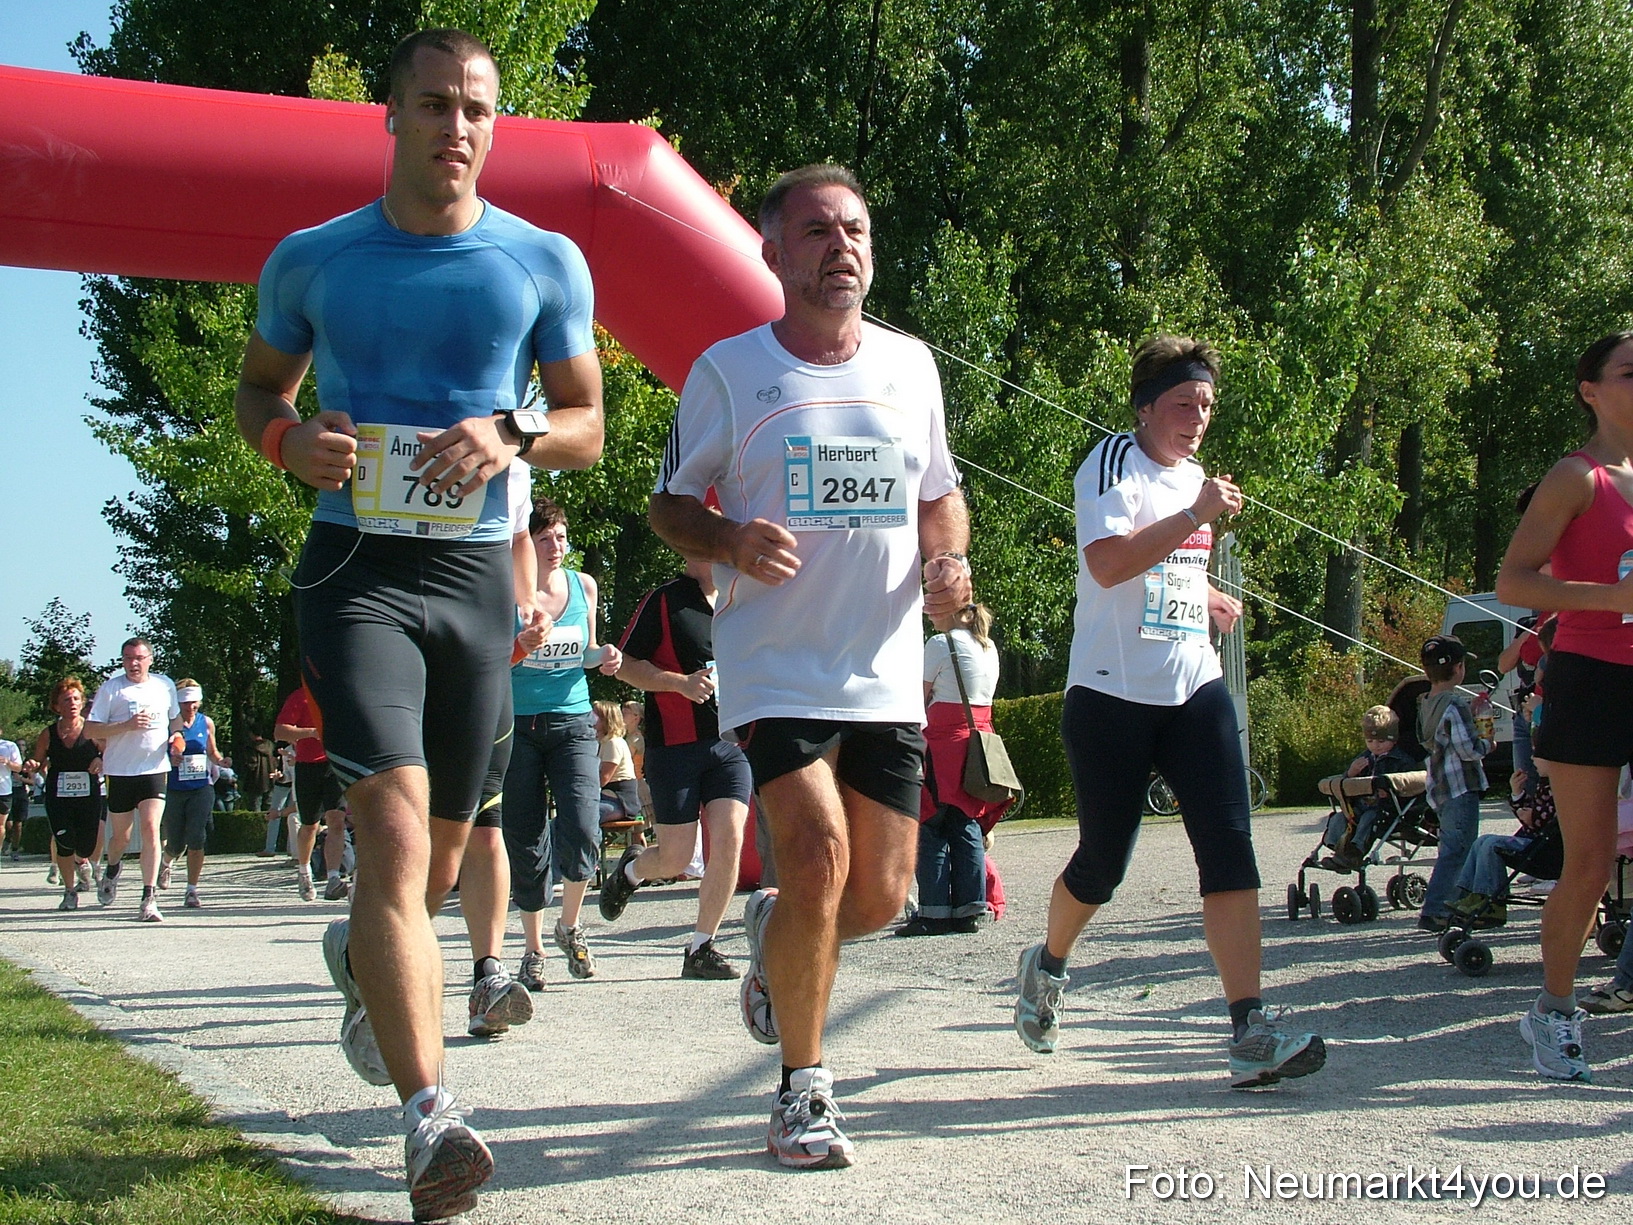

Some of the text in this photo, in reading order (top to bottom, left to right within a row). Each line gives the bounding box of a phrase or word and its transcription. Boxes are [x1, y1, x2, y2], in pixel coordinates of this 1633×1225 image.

[818, 444, 878, 462] Herbert
[358, 466, 366, 480] D
[791, 473, 798, 486] C
[402, 475, 464, 509] 789
[822, 477, 897, 504] 2847
[862, 515, 907, 525] PFLEIDERER
[1149, 592, 1154, 603] D
[1167, 599, 1203, 624] 2748
[543, 642, 579, 658] 3720
[66, 782, 87, 790] 2931
